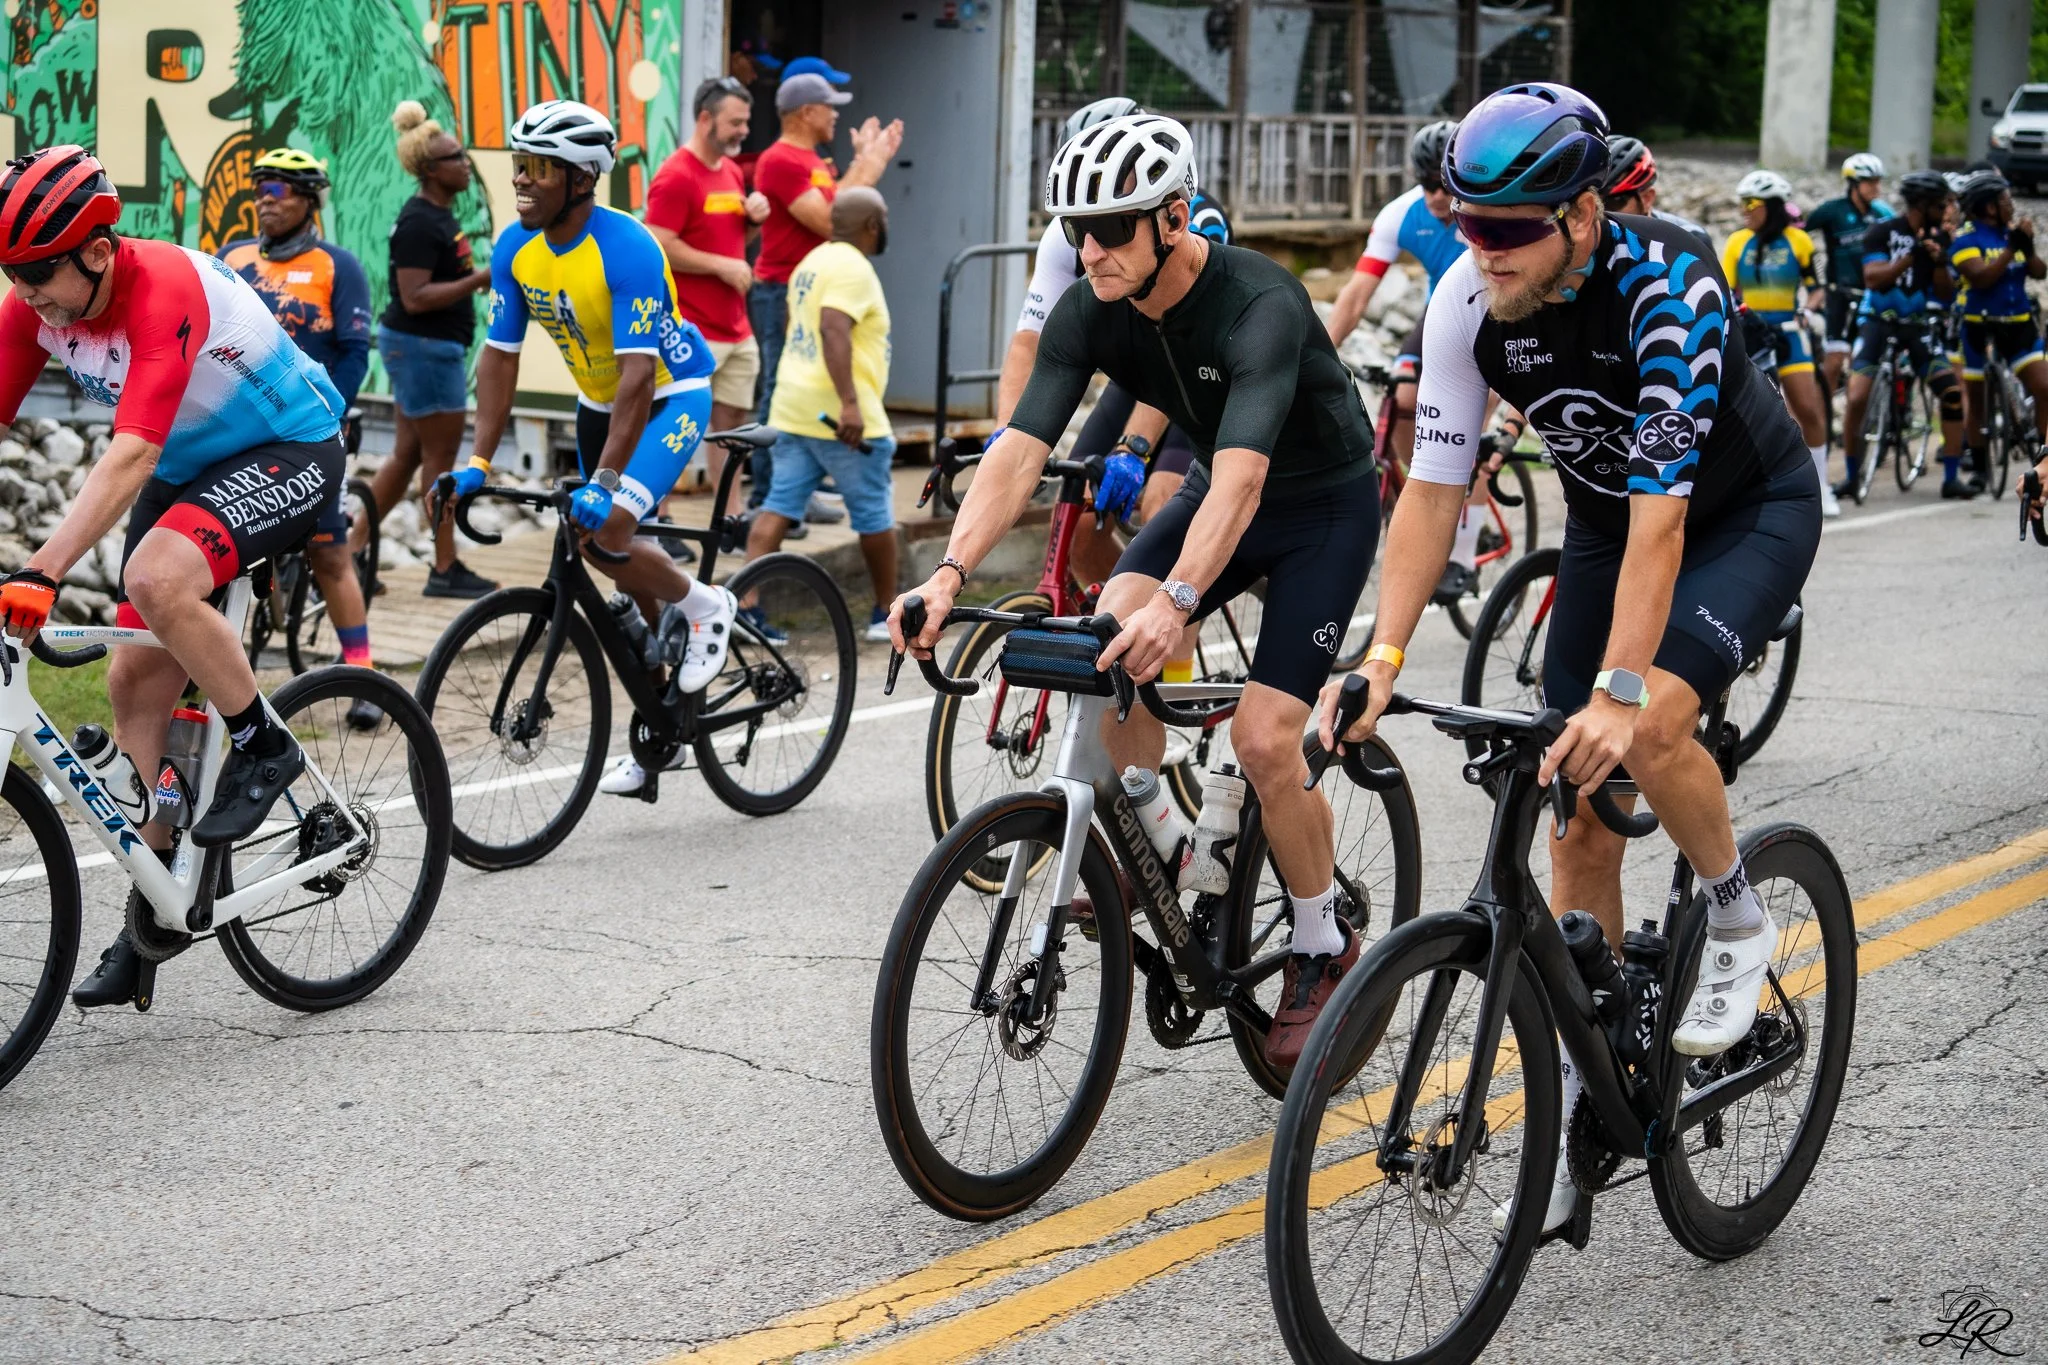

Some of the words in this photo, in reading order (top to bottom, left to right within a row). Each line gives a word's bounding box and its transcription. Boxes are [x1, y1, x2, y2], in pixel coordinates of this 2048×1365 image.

[446, 0, 626, 150] TINY
[41, 175, 77, 214] BONTRAGER
[135, 206, 160, 229] IPA
[1504, 338, 1538, 350] GRIND
[231, 359, 267, 390] PERFORMANCE
[262, 386, 287, 412] COACHING
[220, 462, 326, 529] BENSDORF
[246, 516, 281, 535] Realtors
[288, 492, 324, 519] Memphis
[112, 630, 135, 638] RACING
[1696, 605, 1732, 640] Pedal
[34, 712, 145, 857] TREK
[1113, 792, 1191, 948] cannondale
